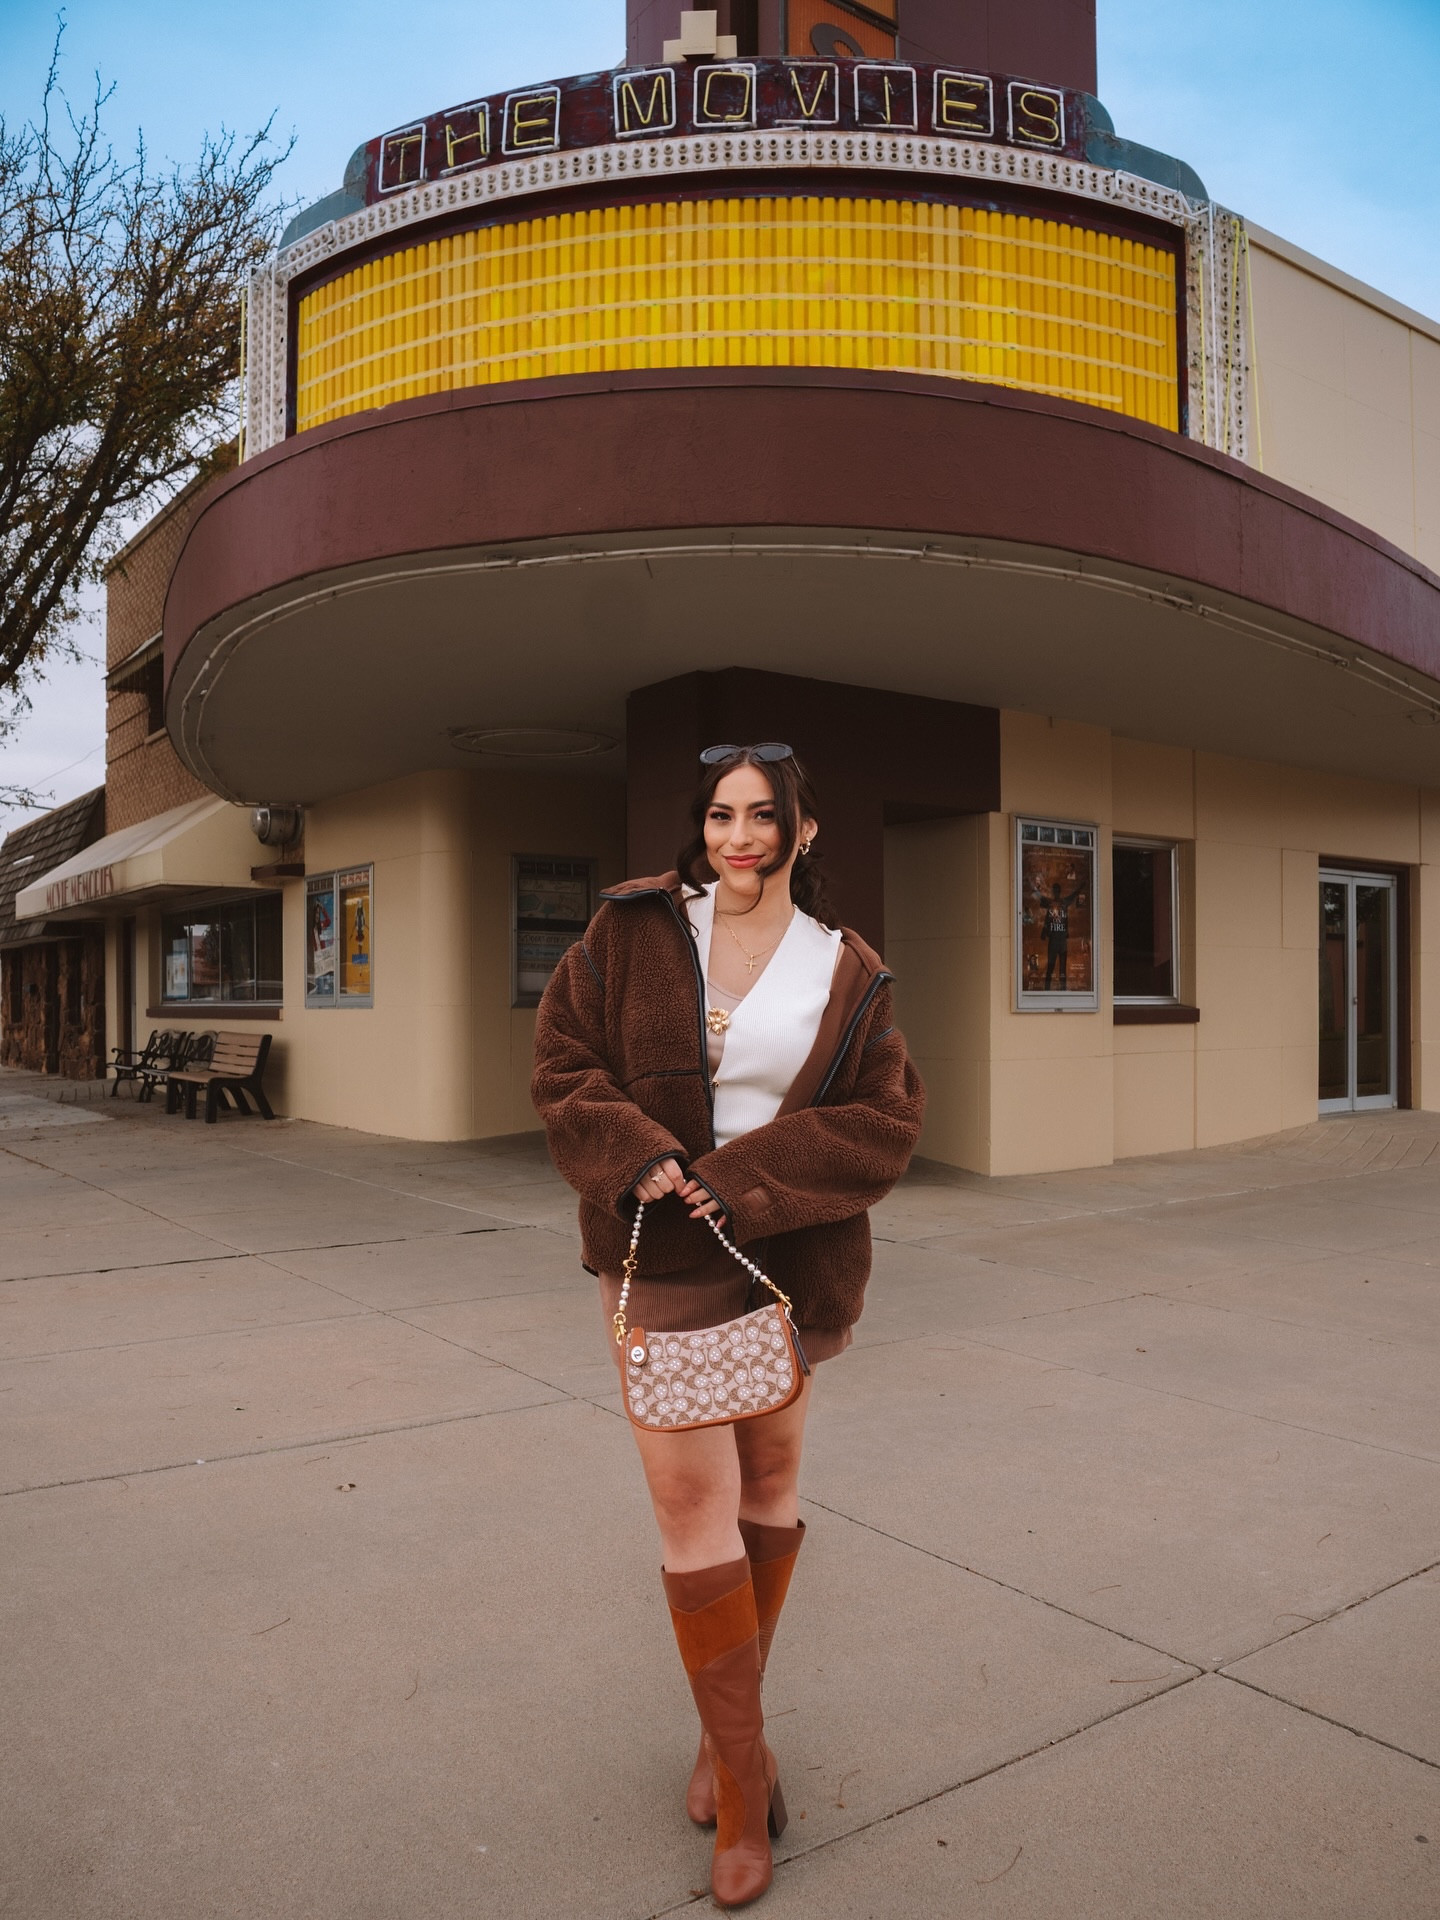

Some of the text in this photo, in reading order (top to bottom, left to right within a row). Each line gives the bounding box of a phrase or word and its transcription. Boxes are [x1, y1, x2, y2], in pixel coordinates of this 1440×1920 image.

[388, 68, 1060, 183] THE MOVIES
[46, 879, 69, 911] MOVIE
[1048, 908, 1067, 919] SOUL
[1050, 922, 1066, 932] FIRE
